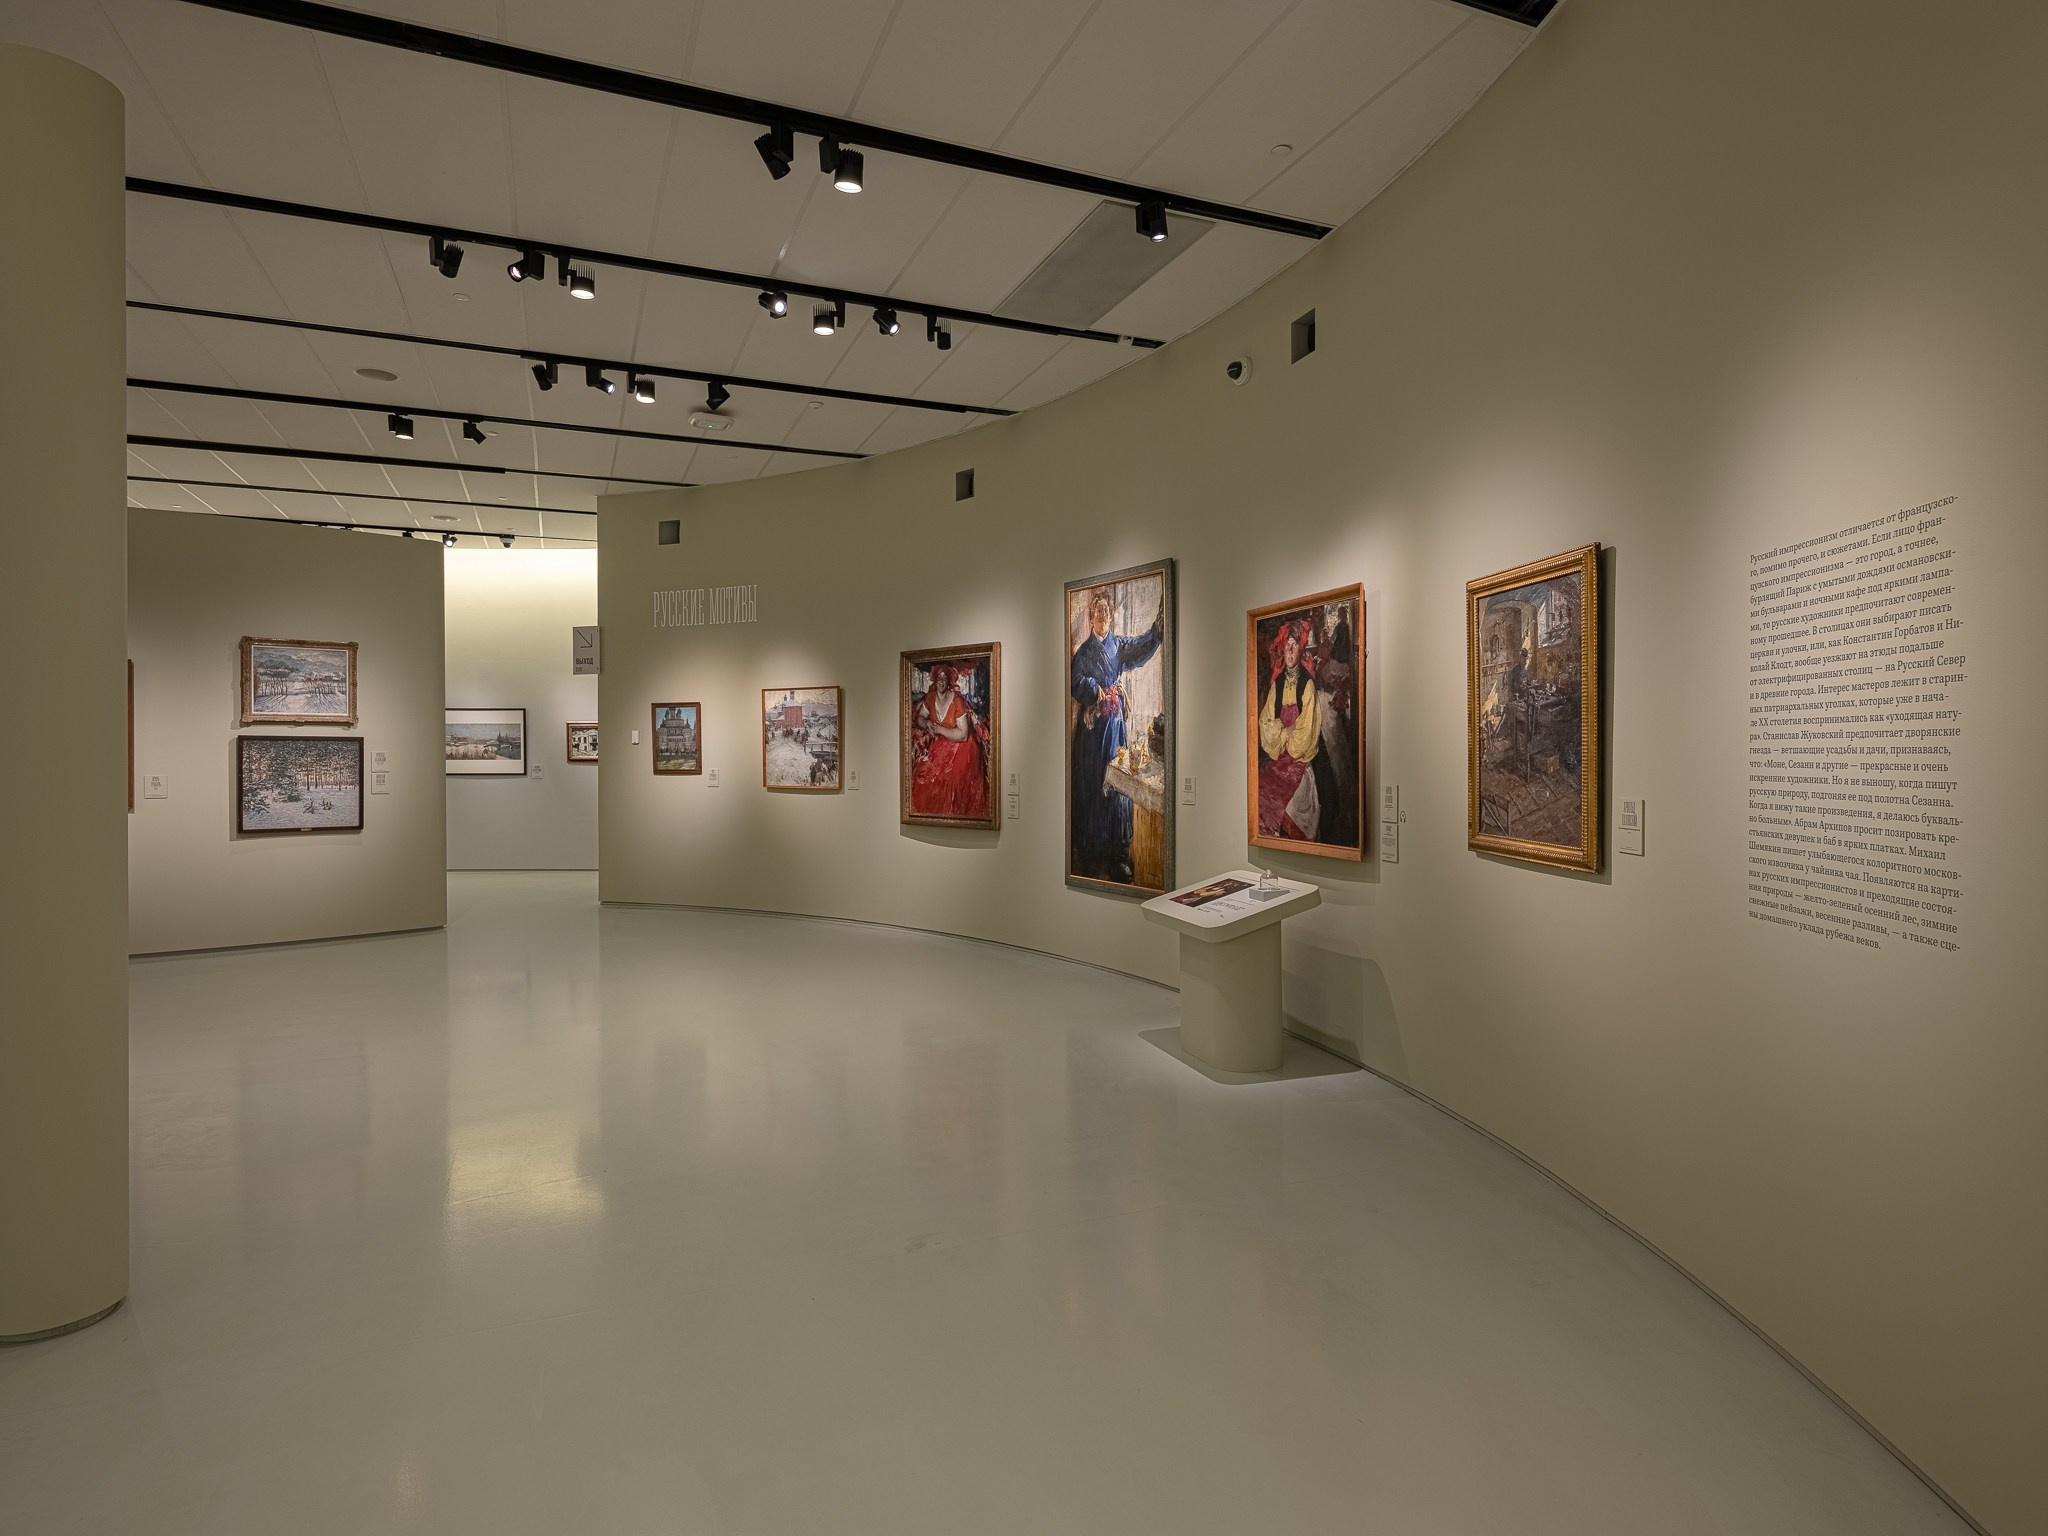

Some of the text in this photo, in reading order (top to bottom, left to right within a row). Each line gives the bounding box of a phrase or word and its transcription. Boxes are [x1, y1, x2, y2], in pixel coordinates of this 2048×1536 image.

[1750, 496, 1958, 565] Русский импрессионизм отличается от французско-
[1760, 517, 1946, 574] помимо прочего, сюжетами. Если лицо фран-
[1750, 550, 1956, 606] бурлящий Париж умытыми дождями османовски-
[1781, 536, 1939, 583] импрессионизма это город, точнее,
[653, 584, 758, 628] РУССКИЕ МОТИВЫ
[1761, 568, 1954, 618] бульварами ночными кафе под яркими лампа-
[1771, 585, 1956, 630] русские художники предпочитают современ-
[1750, 618, 1964, 660] церкви улочки, или, как Константин Горбатов Ни-
[1768, 604, 1952, 644] прошедшее. столицах они выбирают писать
[576, 657, 594, 665] ВЫХОД
[1750, 640, 1944, 672] колай Клодт, вообще уезжают на этюды подальше
[1758, 655, 1966, 686] электрифицированных столиц на Русский Север
[1760, 674, 1968, 701] древние города. Интерес мастеров лежит старин-
[1764, 693, 1949, 714] патриархальных уголках, которые уже нача-
[1762, 728, 1961, 742] Станислав Жуковский предпочитает дворянские
[1803, 715, 1868, 727] воспринимались
[1870, 714, 1884, 722] как
[1886, 712, 1934, 724] «уходящая
[1936, 710, 1962, 721] нату-
[1764, 759, 1948, 774] «Моне, Сезанн другие прекрасные очень
[1781, 747, 1825, 755] ветшающие
[1826, 744, 1858, 757] усадьбы
[1866, 746, 1888, 756] дачи,
[1890, 746, 1951, 757] признаваясь,
[1749, 774, 1786, 784] искренние
[1787, 776, 1830, 786] художники.
[1832, 775, 1843, 785] Но
[1861, 778, 1897, 790] выношу,
[1898, 780, 1923, 790] когда
[1925, 781, 1958, 792] пишут
[1749, 788, 1777, 798] русскую
[1778, 790, 1810, 801] природу,
[1811, 792, 1846, 800] подгоняя
[1858, 794, 1873, 804] под
[1874, 795, 1910, 805] полотна
[1911, 795, 1954, 808] Сезанна.
[1749, 799, 1964, 826] Когда вижу такие произведения, делаюсь букваль-
[1758, 814, 1959, 846] больным». Абрам Архипов просит позировать кре-
[1748, 829, 1946, 860] стьянских девушек баб ярких платках. Михаил
[1748, 840, 1962, 880] Шемякин пишет улыбающегося колоритного москов-
[1762, 872, 1957, 915] русских импрессионистов преходящие состоя-
[1767, 859, 1964, 898] извозчика чайника чая. Появляются на карти-
[1748, 897, 1960, 952] снежные пейзажи, весенние разливы, также сце-
[1762, 886, 1957, 934] природы желто-зеленый осенний лес, зимние
[1759, 913, 1881, 950] домашнего уклада рубежа веков.
